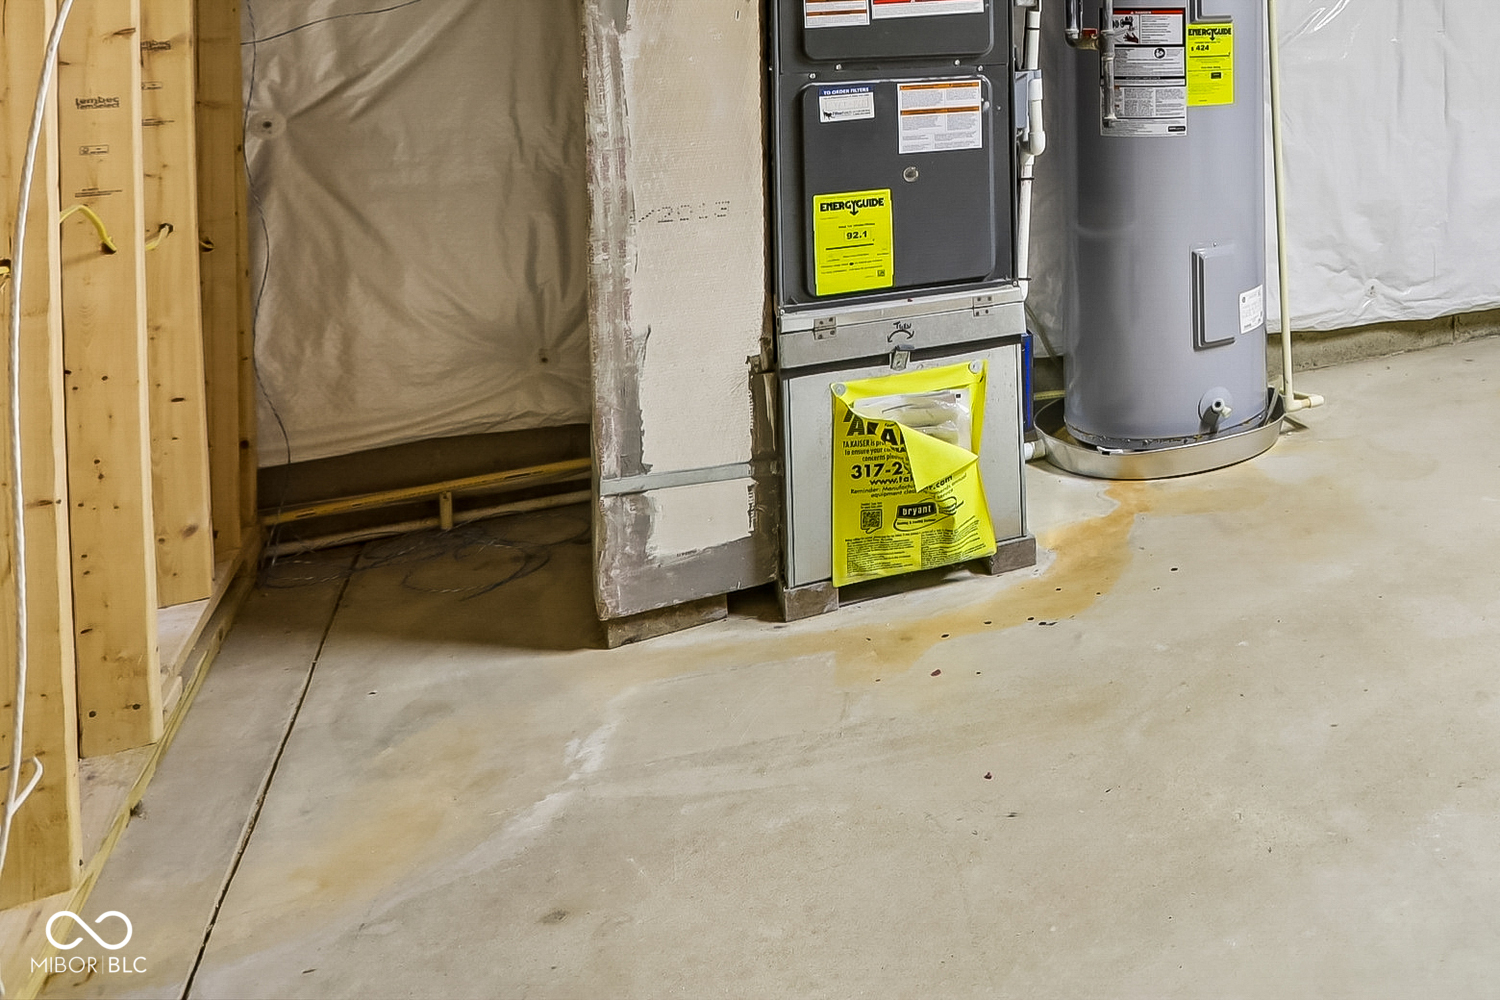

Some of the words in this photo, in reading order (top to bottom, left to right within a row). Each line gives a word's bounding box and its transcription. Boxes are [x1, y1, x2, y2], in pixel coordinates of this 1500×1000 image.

[1188, 27, 1232, 37] ENERGYGUIDE
[820, 197, 885, 213] ENERGYGUIDE
[846, 230, 868, 240] 92.1
[851, 461, 903, 479] 317-2
[902, 505, 932, 516] bryant
